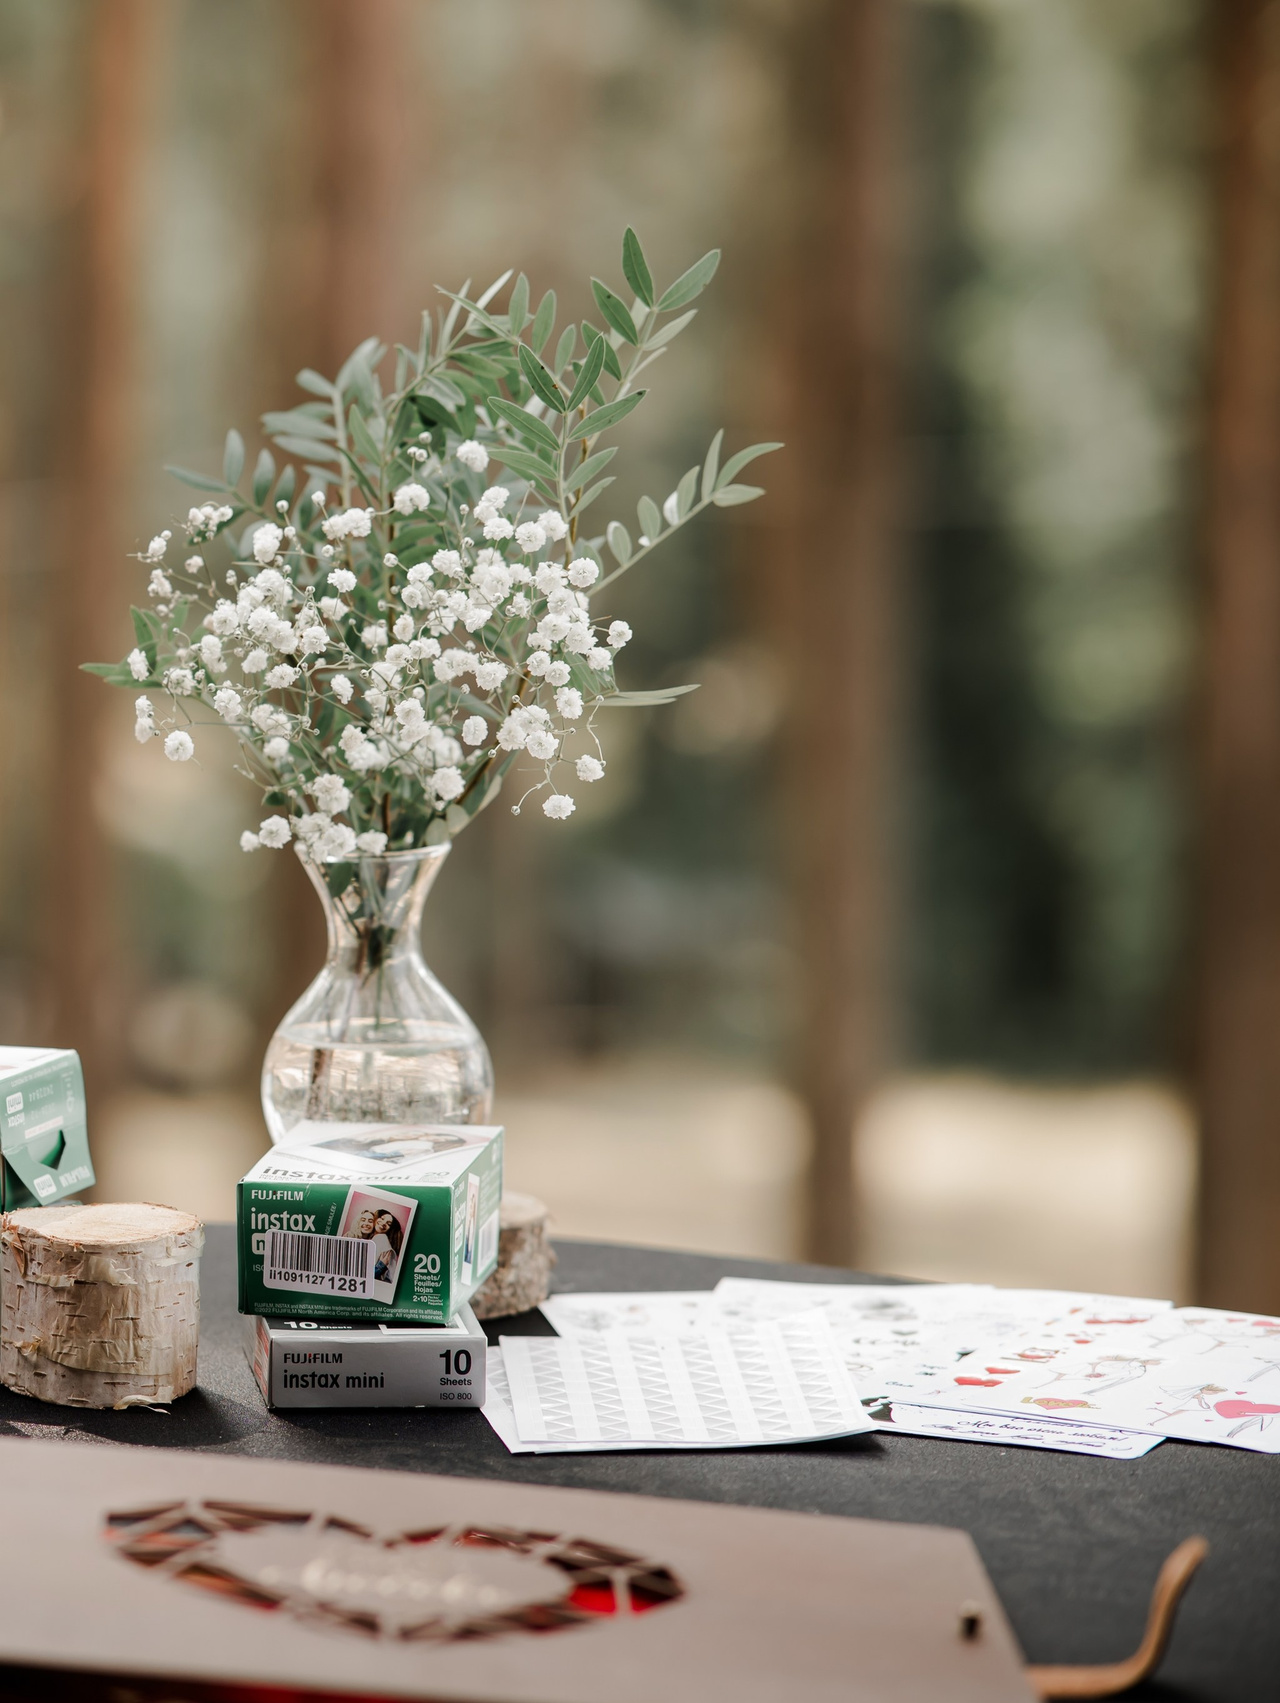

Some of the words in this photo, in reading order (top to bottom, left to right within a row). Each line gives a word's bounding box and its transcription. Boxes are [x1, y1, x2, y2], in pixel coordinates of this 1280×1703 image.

[263, 1167, 355, 1181] instax
[251, 1190, 303, 1201] FUJIFILM
[251, 1207, 316, 1231] instax
[414, 1254, 440, 1273] 20
[328, 1277, 366, 1293] 1281
[284, 1321, 318, 1329] 10
[284, 1353, 343, 1364] FUJIFILM
[439, 1350, 472, 1375] 10
[284, 1370, 340, 1388] instax
[346, 1372, 385, 1388] mini
[440, 1378, 472, 1386] Sheets
